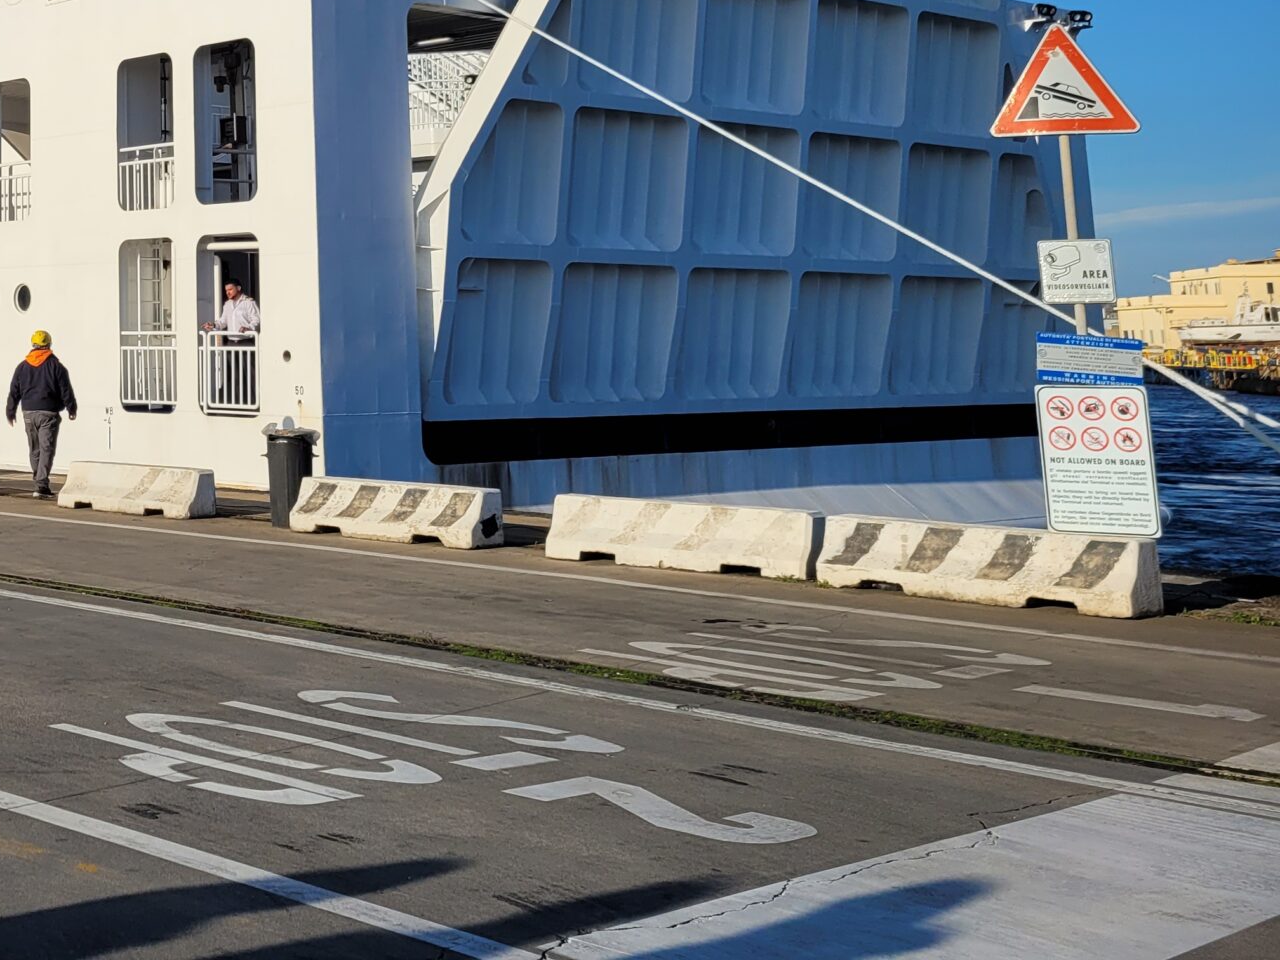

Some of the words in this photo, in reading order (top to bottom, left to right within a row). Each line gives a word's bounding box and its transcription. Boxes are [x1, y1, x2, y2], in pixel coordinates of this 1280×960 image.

[1082, 270, 1108, 279] AREA
[1046, 282, 1110, 290] VIDEOSORVEGLIATA
[1064, 372, 1116, 380] WARNING
[294, 385, 304, 396] 50
[1068, 457, 1102, 465] ALLOWED
[49, 690, 624, 806] STOP
[502, 776, 818, 844] 2
